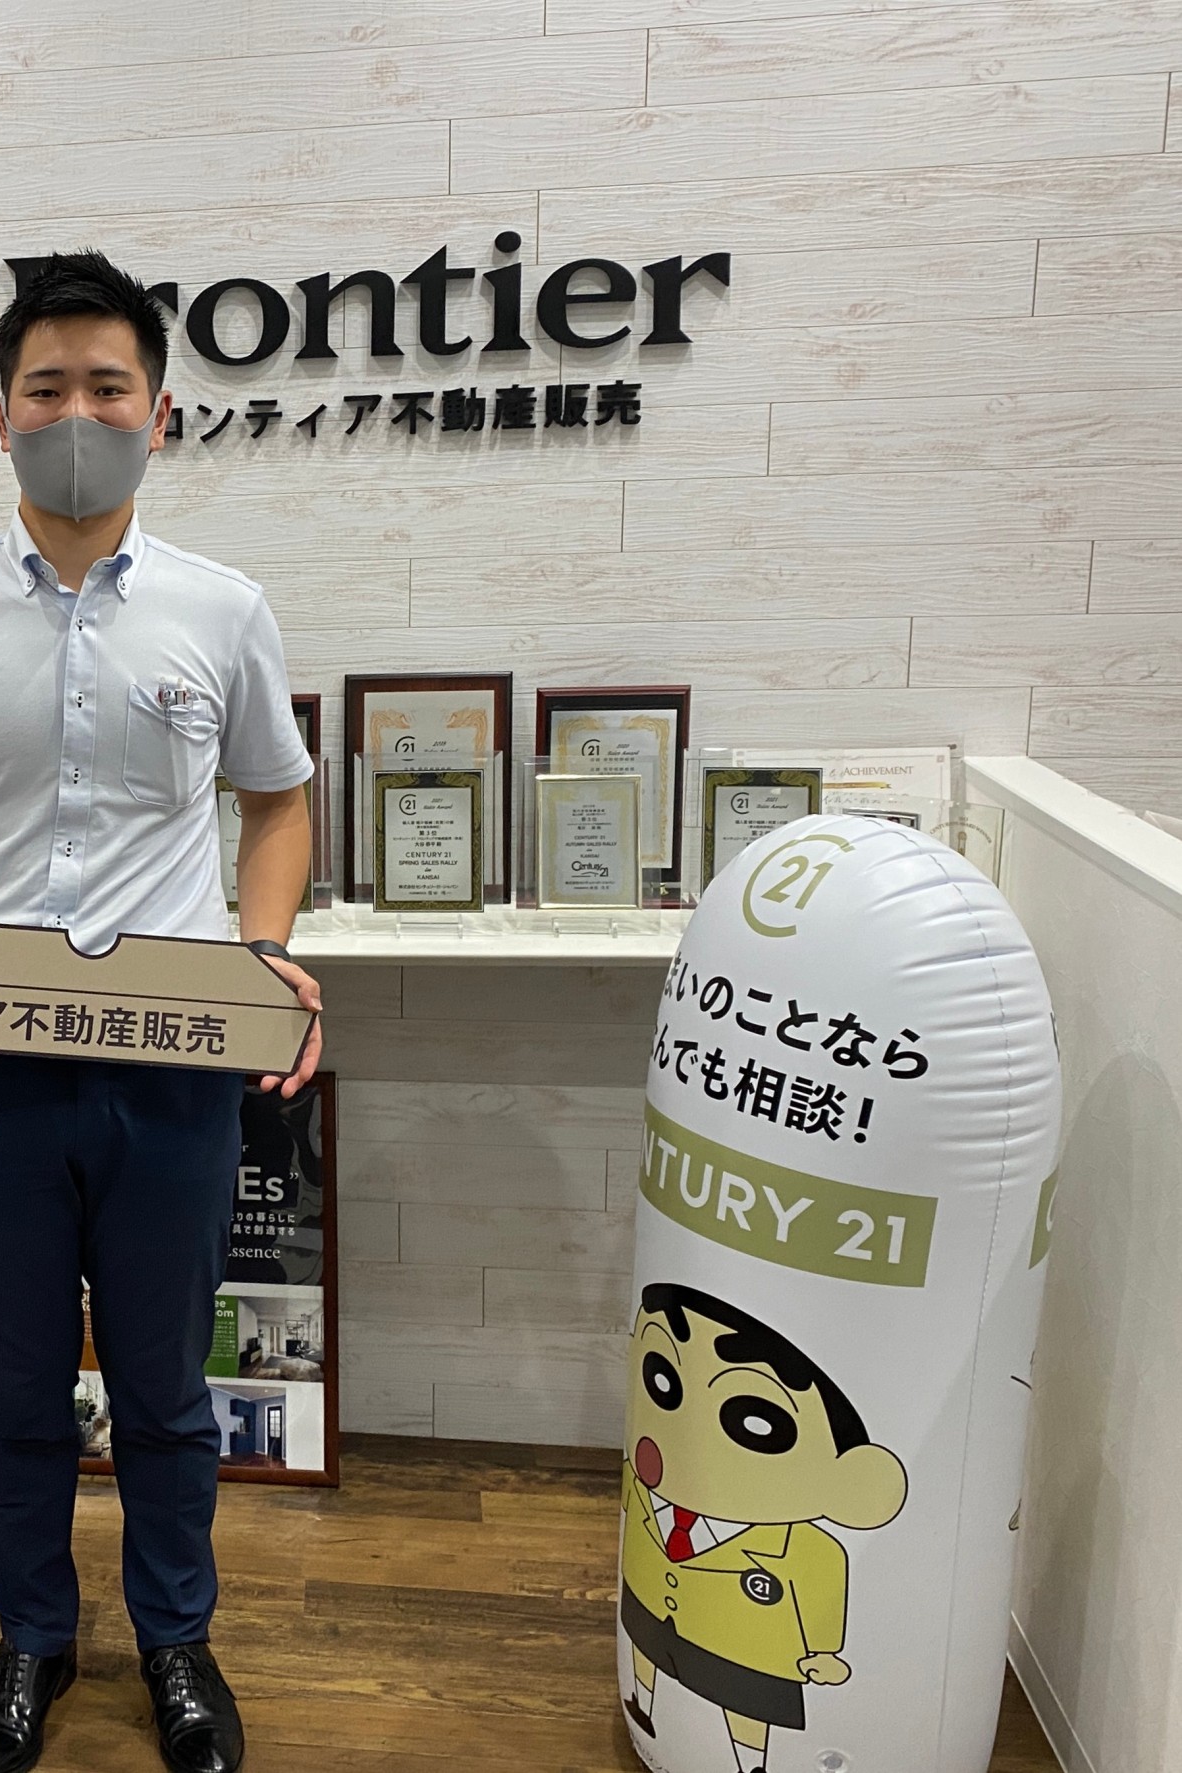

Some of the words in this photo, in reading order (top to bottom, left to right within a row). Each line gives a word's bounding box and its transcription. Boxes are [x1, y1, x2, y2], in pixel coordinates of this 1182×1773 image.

[164, 380, 643, 443] ロンティア不動産販売
[844, 765, 914, 776] ACHIEVEMENT
[650, 1022, 875, 1144] んでも相談！
[228, 1246, 282, 1260] ssence
[833, 1209, 907, 1265] 21
